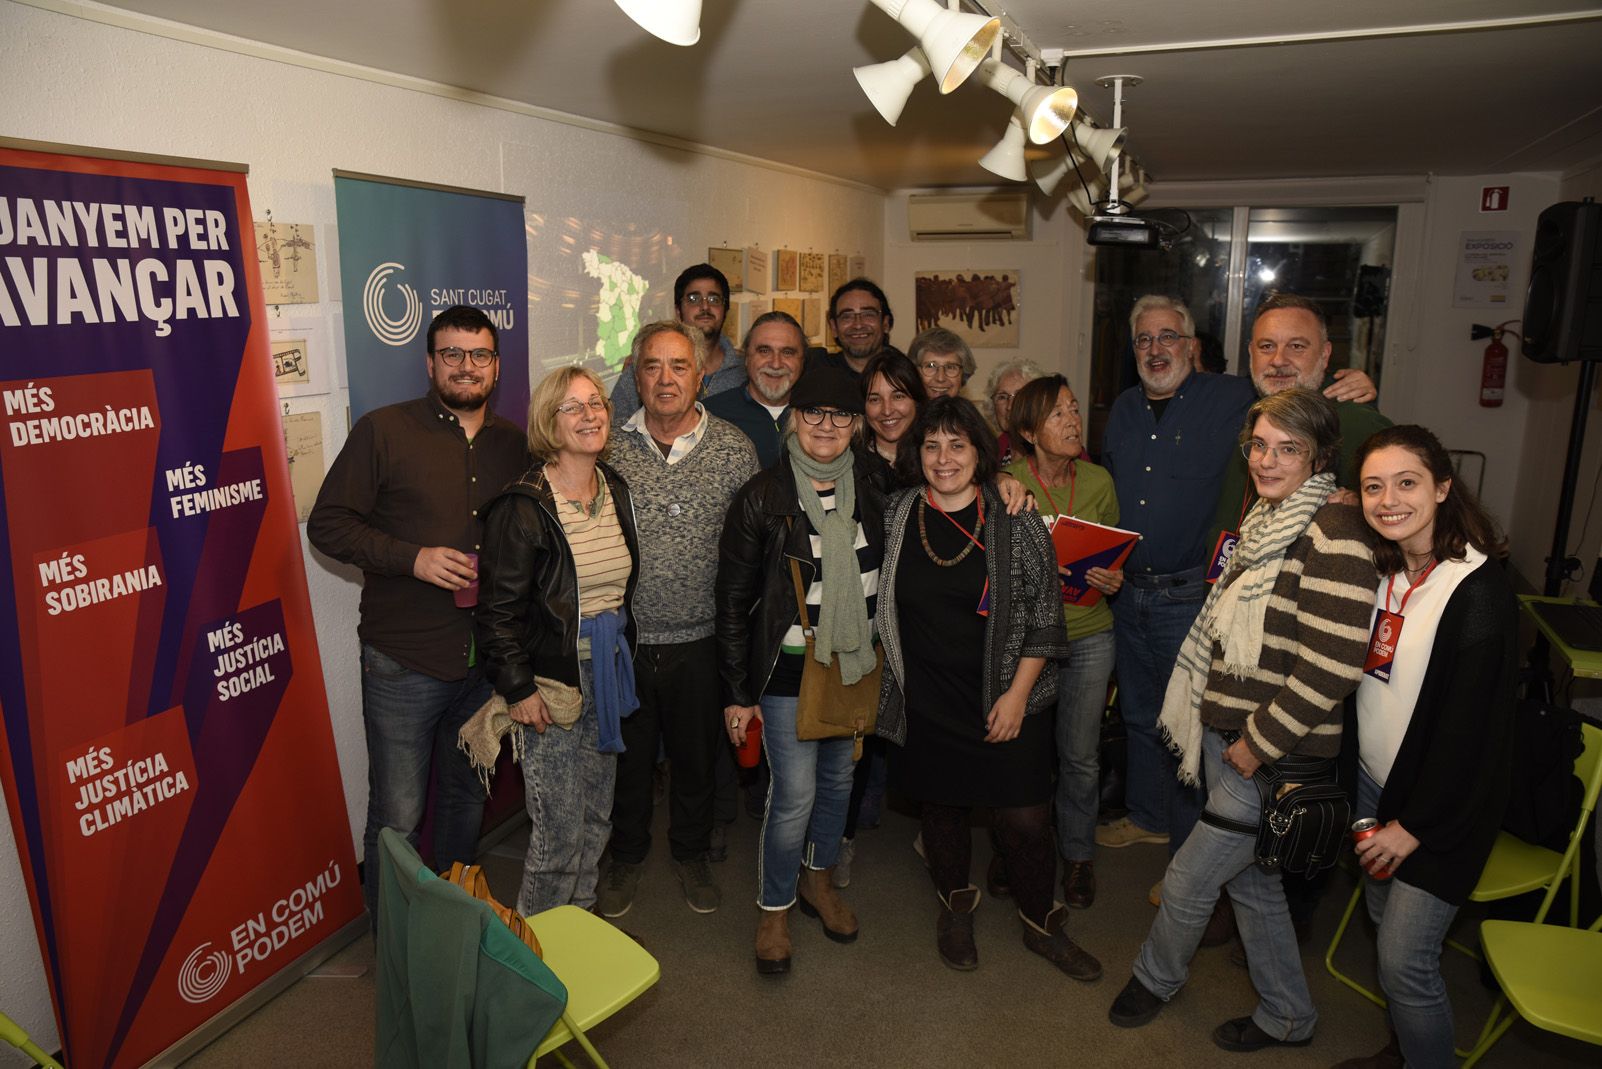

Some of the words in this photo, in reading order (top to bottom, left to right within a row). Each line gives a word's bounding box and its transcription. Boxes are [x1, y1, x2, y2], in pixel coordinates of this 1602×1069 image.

[163, 208, 230, 250] PER
[431, 288, 465, 305] SANT
[468, 289, 506, 305] CUGAT
[3, 381, 54, 415] MÉS
[10, 405, 155, 446] DEMOCRÀCIA
[166, 461, 206, 491] MÉS
[171, 479, 263, 518] FEMINISME
[39, 552, 87, 586] MÉS
[46, 565, 162, 615] SOBIRANIA
[207, 621, 243, 652] MÉS
[214, 633, 284, 677] JUSTÍCIA
[217, 666, 274, 702] SOCIAL
[66, 746, 113, 784] MÉS
[75, 753, 168, 810] JUSTÍCIA
[80, 771, 189, 837] CLIMÀTICA
[231, 913, 266, 951] EN
[272, 860, 341, 923] COMÚ
[236, 874, 326, 974] PODEM
